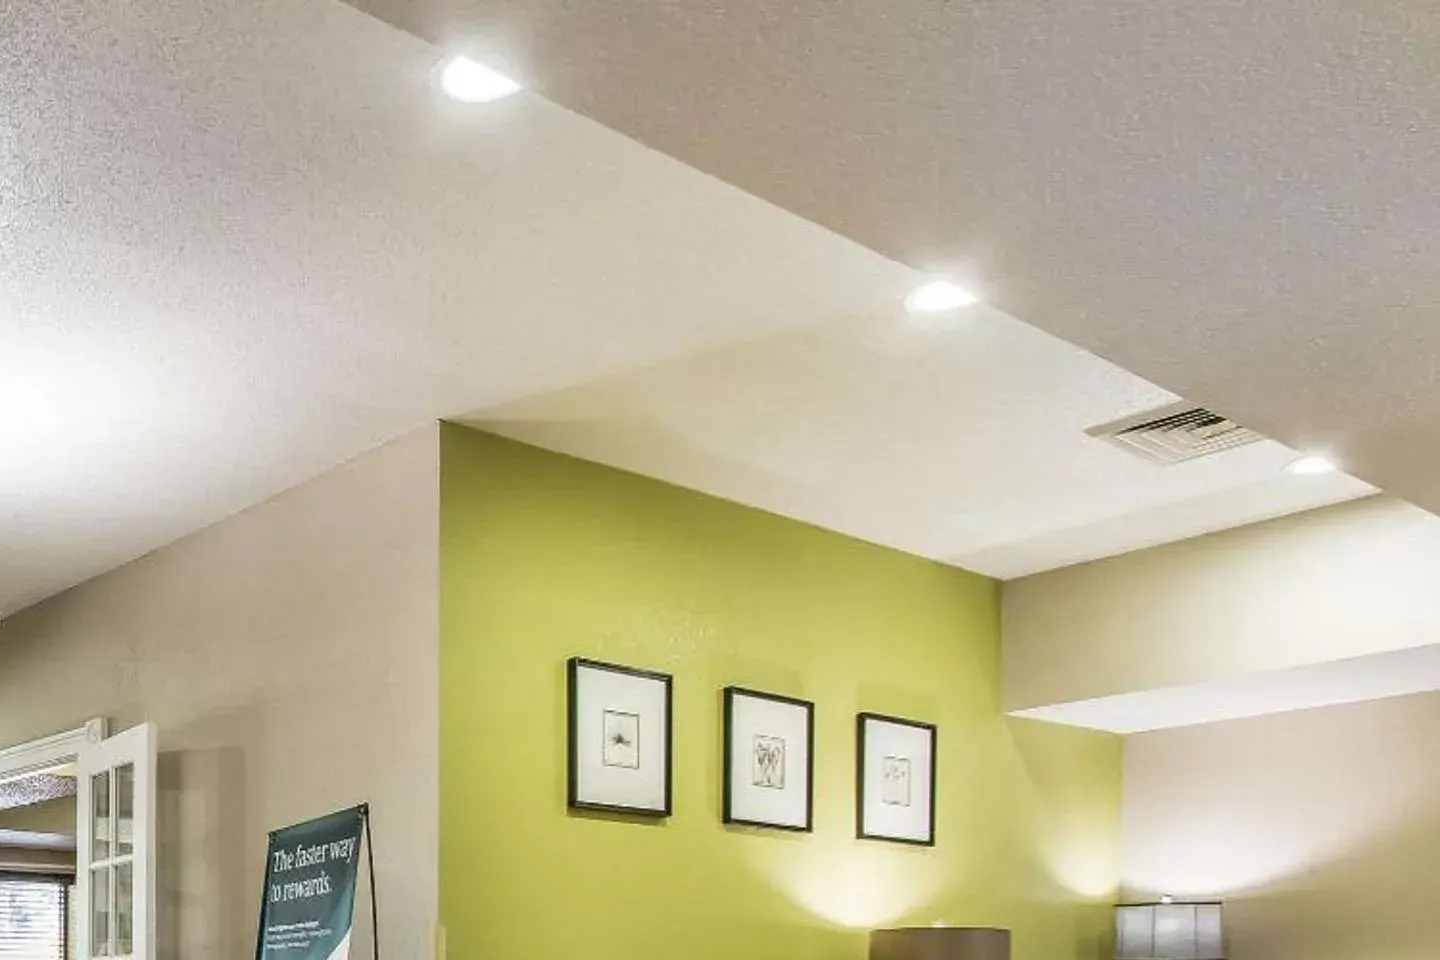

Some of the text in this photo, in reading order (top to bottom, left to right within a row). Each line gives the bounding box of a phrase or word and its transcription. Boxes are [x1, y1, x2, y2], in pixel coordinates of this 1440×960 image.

[273, 837, 357, 873] The faster way
[270, 883, 281, 903] to
